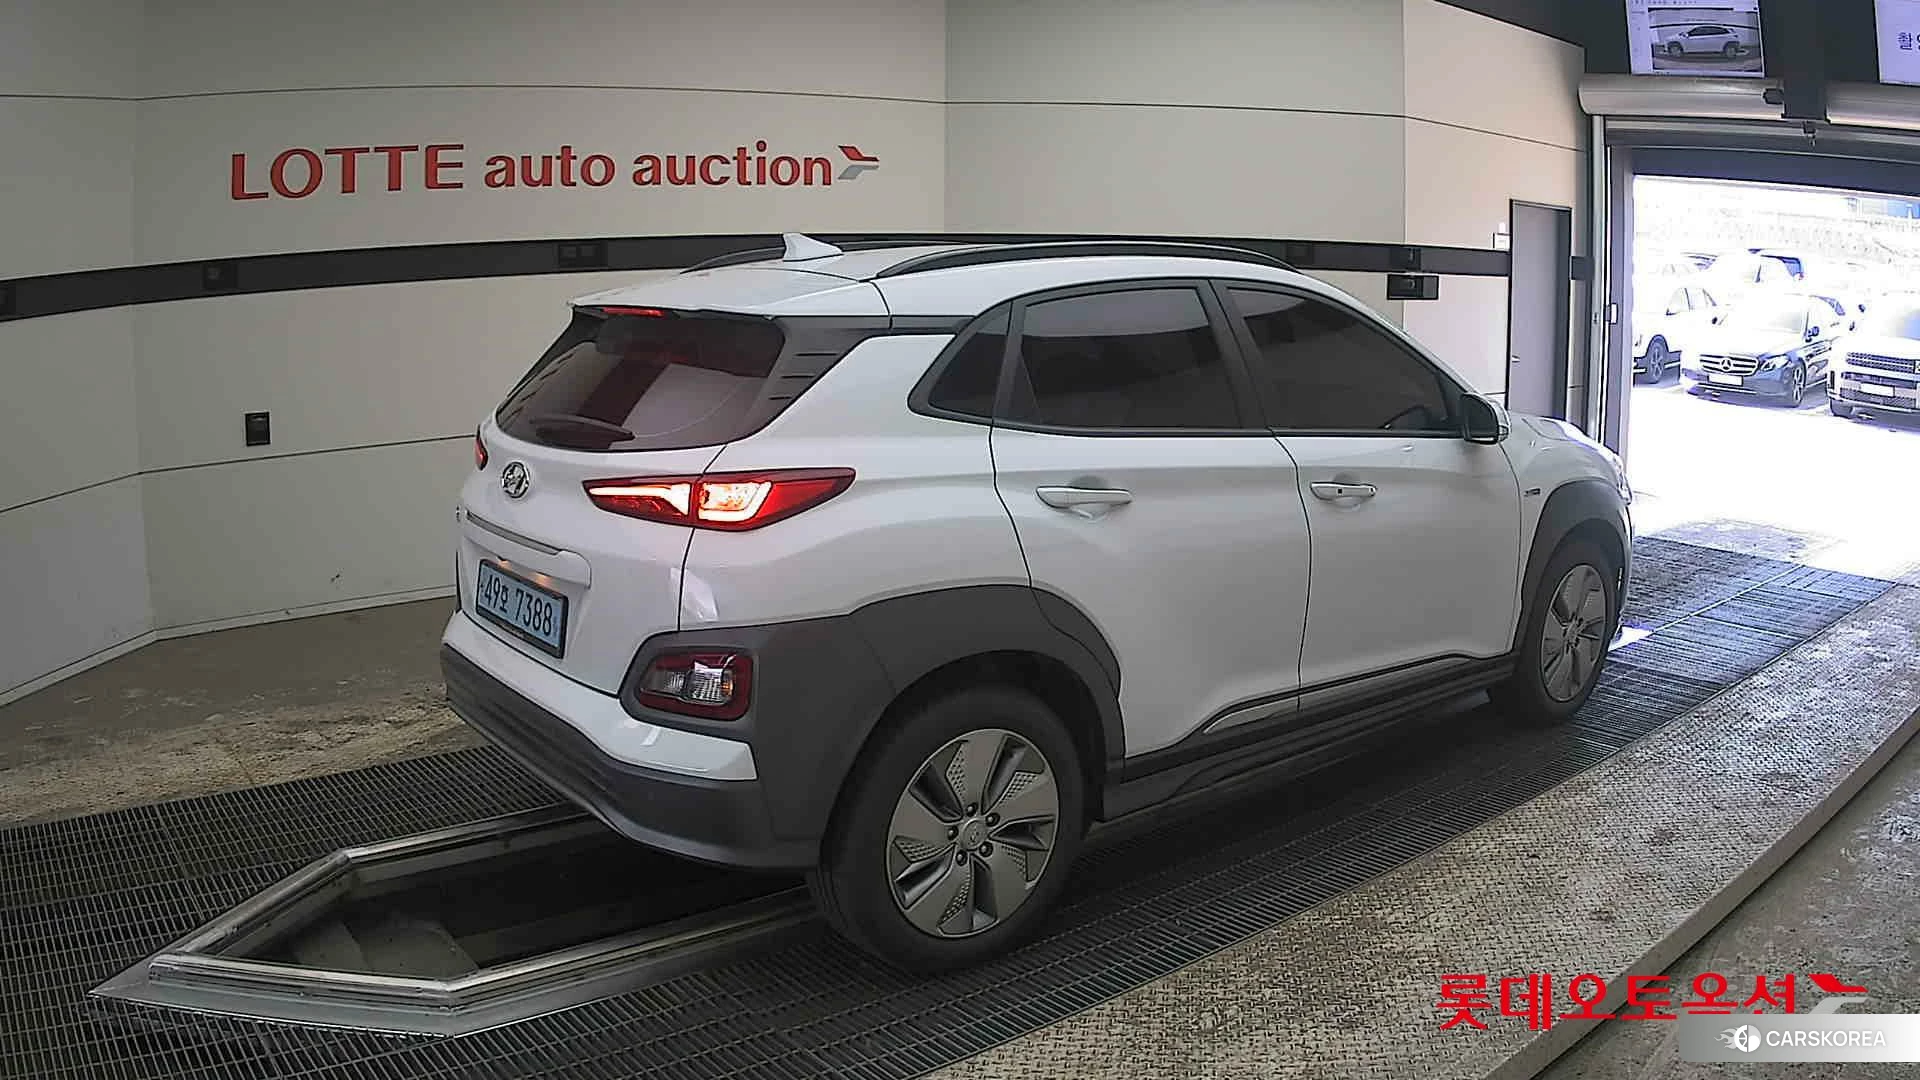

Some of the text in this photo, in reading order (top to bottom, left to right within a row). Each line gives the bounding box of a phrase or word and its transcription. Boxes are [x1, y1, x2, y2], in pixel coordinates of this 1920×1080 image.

[231, 141, 832, 200] LOTTE auto auction
[515, 588, 553, 637] 7388
